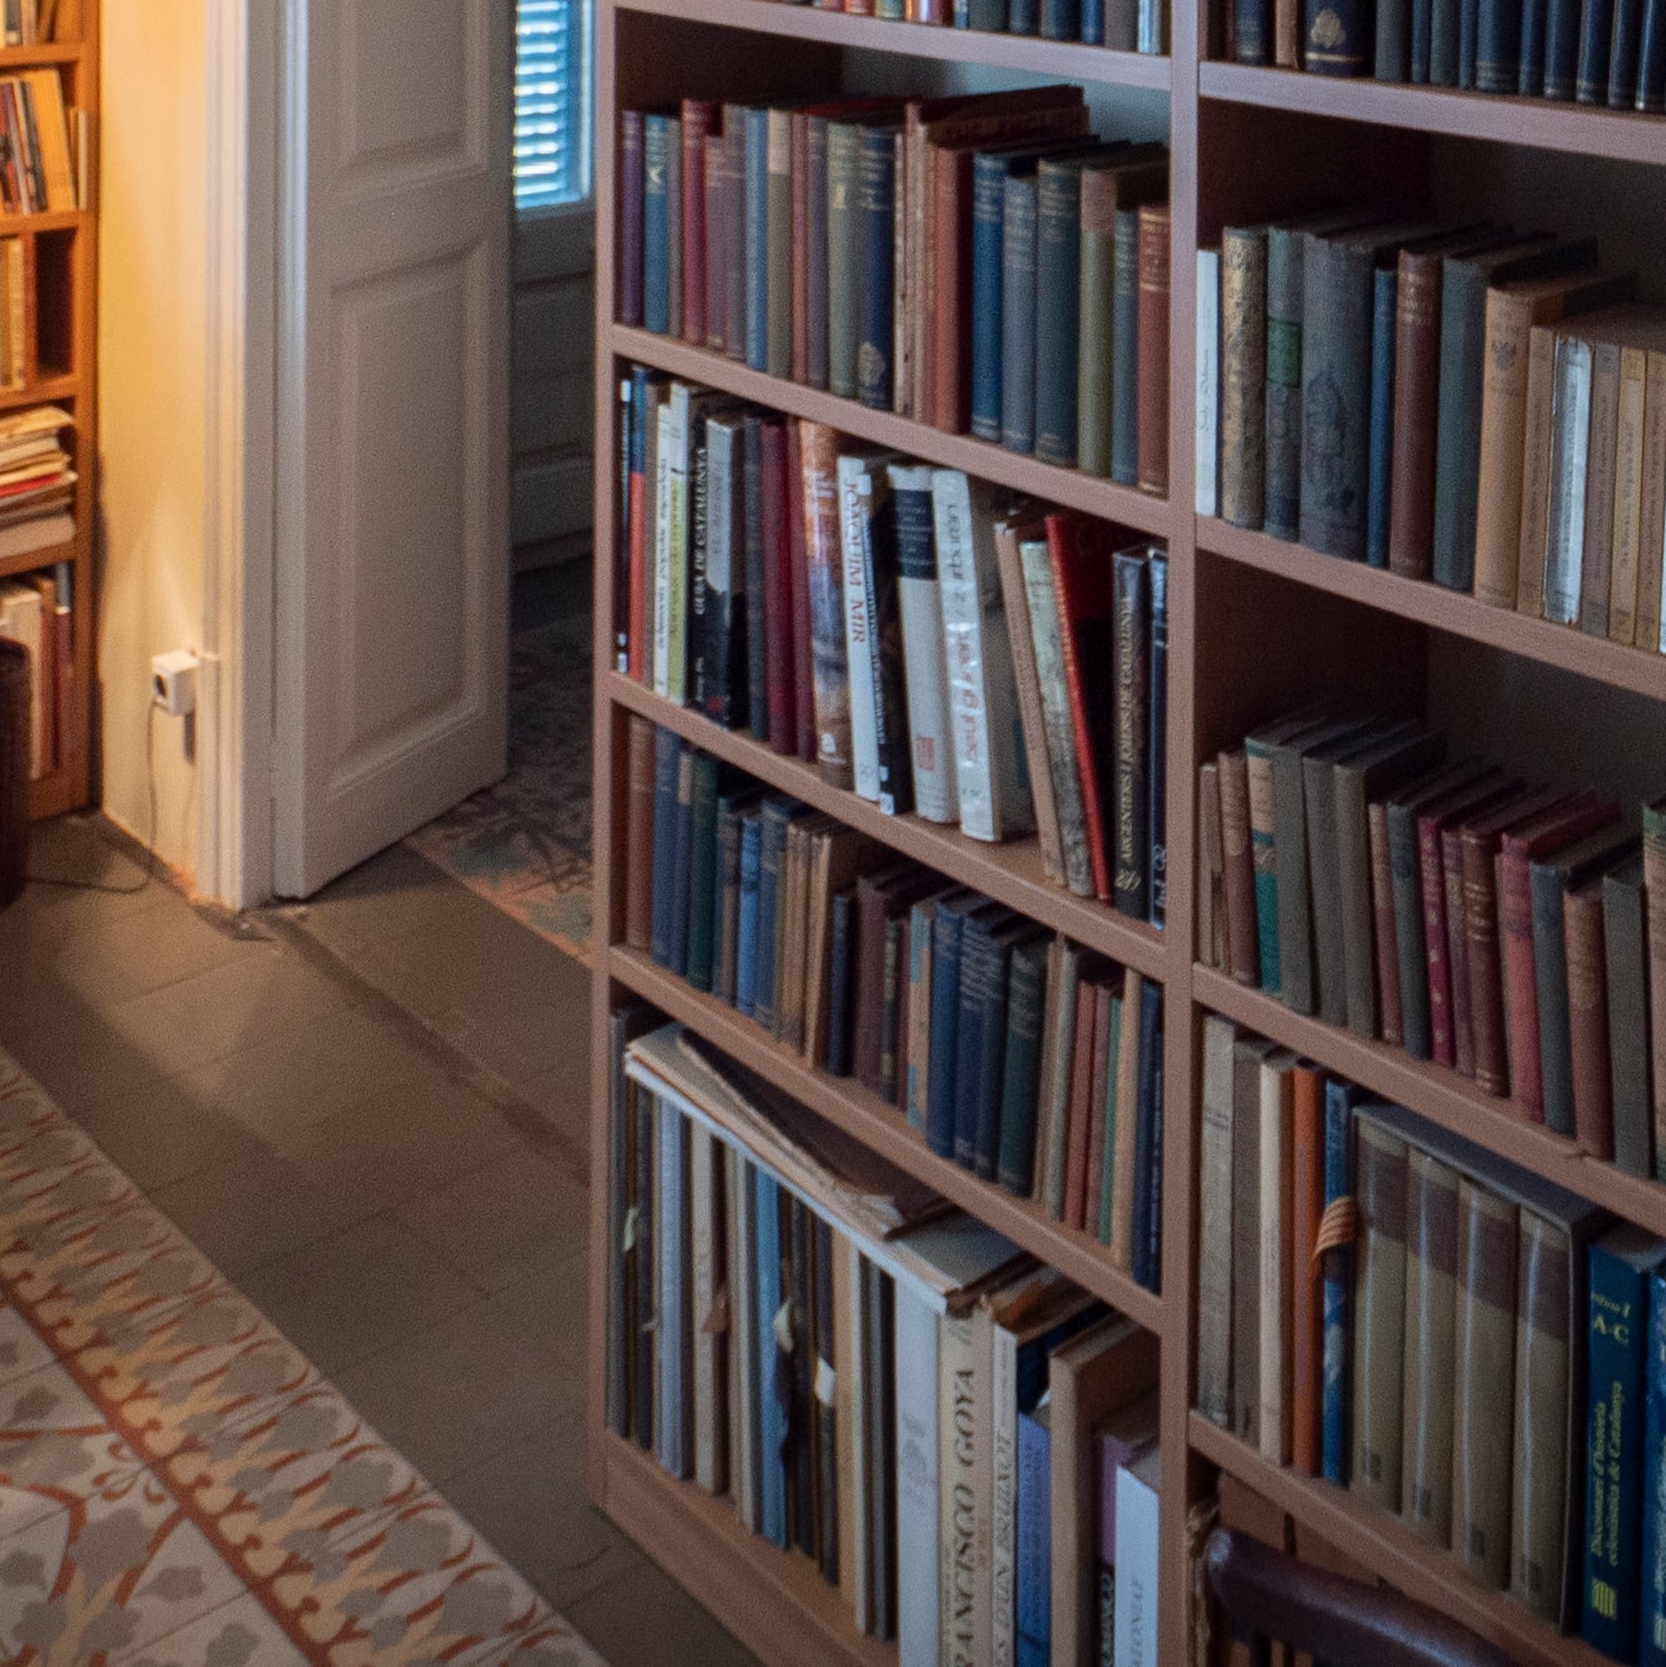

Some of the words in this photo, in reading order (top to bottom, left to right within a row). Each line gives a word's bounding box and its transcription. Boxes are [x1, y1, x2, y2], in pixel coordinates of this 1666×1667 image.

[848, 484, 867, 588] JOAQUIM
[849, 597, 867, 645] MIR
[1592, 1314, 1631, 1347] A-C
[953, 1368, 975, 1468] GOYA
